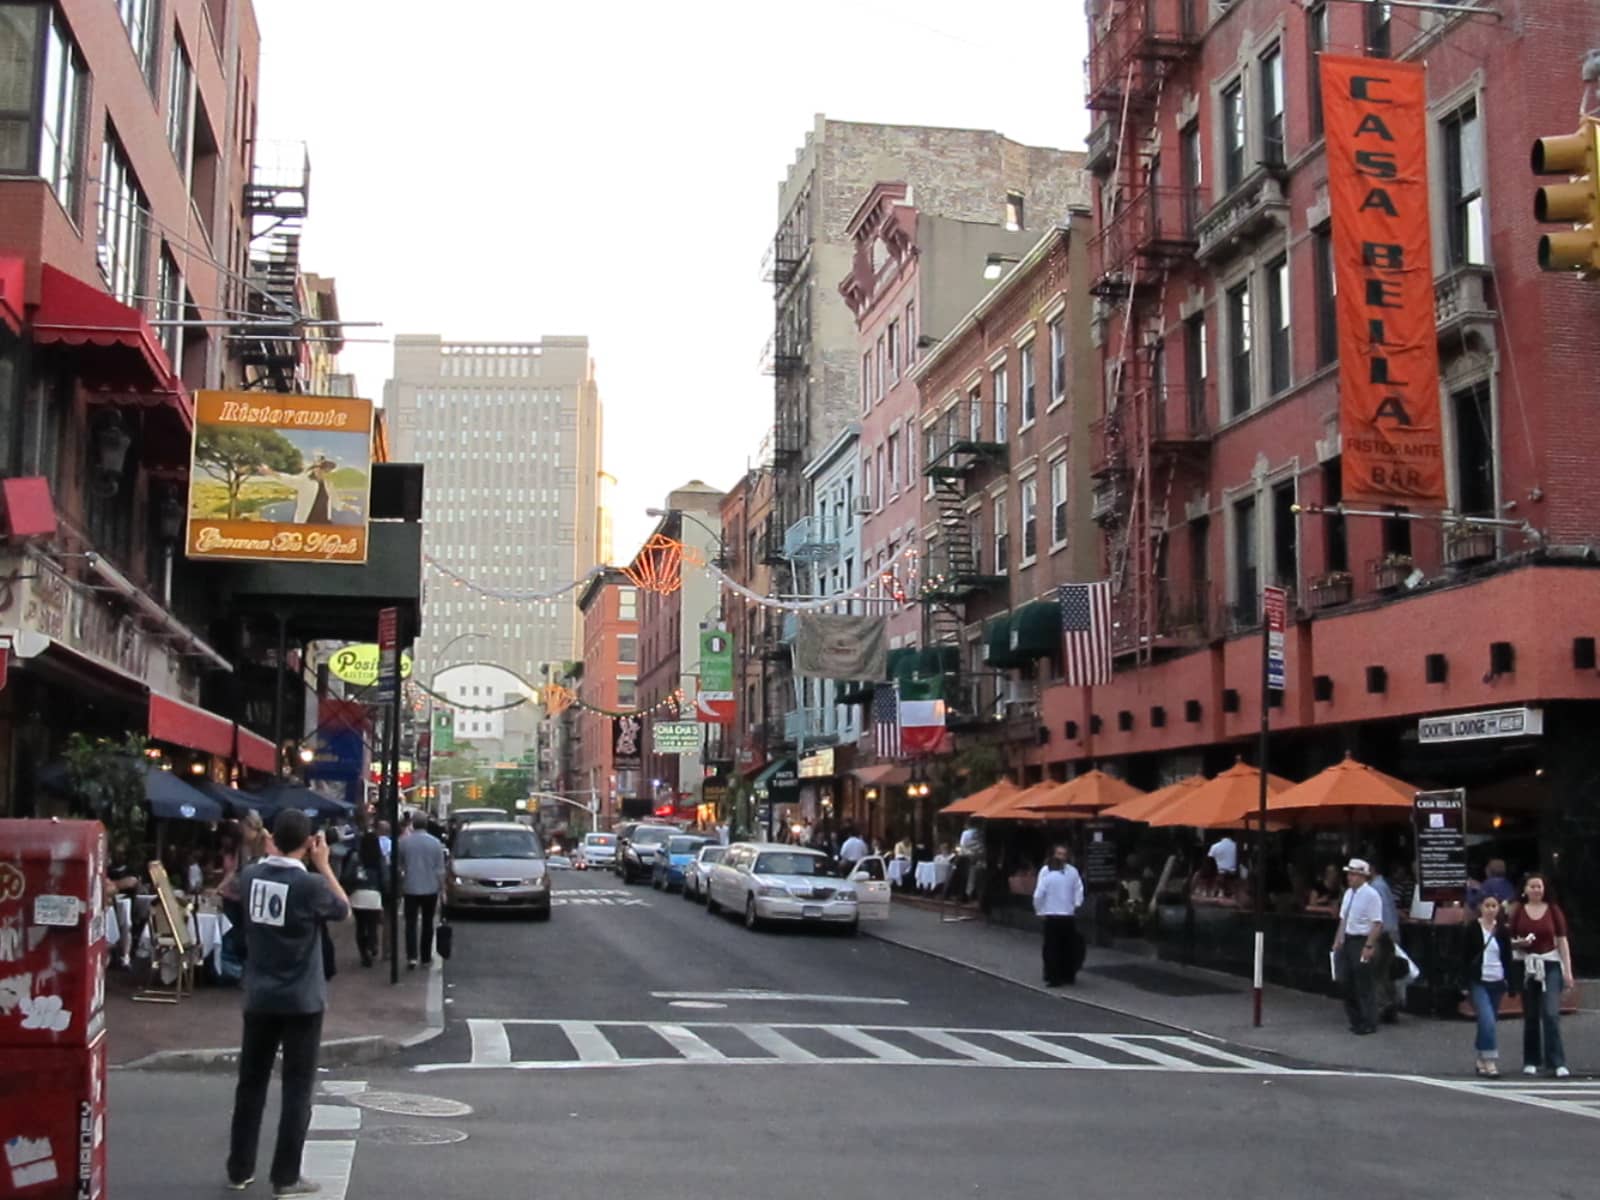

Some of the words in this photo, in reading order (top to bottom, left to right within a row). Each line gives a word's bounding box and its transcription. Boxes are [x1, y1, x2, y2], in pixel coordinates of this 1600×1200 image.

[1348, 75, 1399, 217] CASA
[1361, 241, 1412, 427] BELLA
[219, 401, 348, 426] Ristorante
[1371, 466, 1422, 487] BAR
[337, 650, 409, 673] Posio
